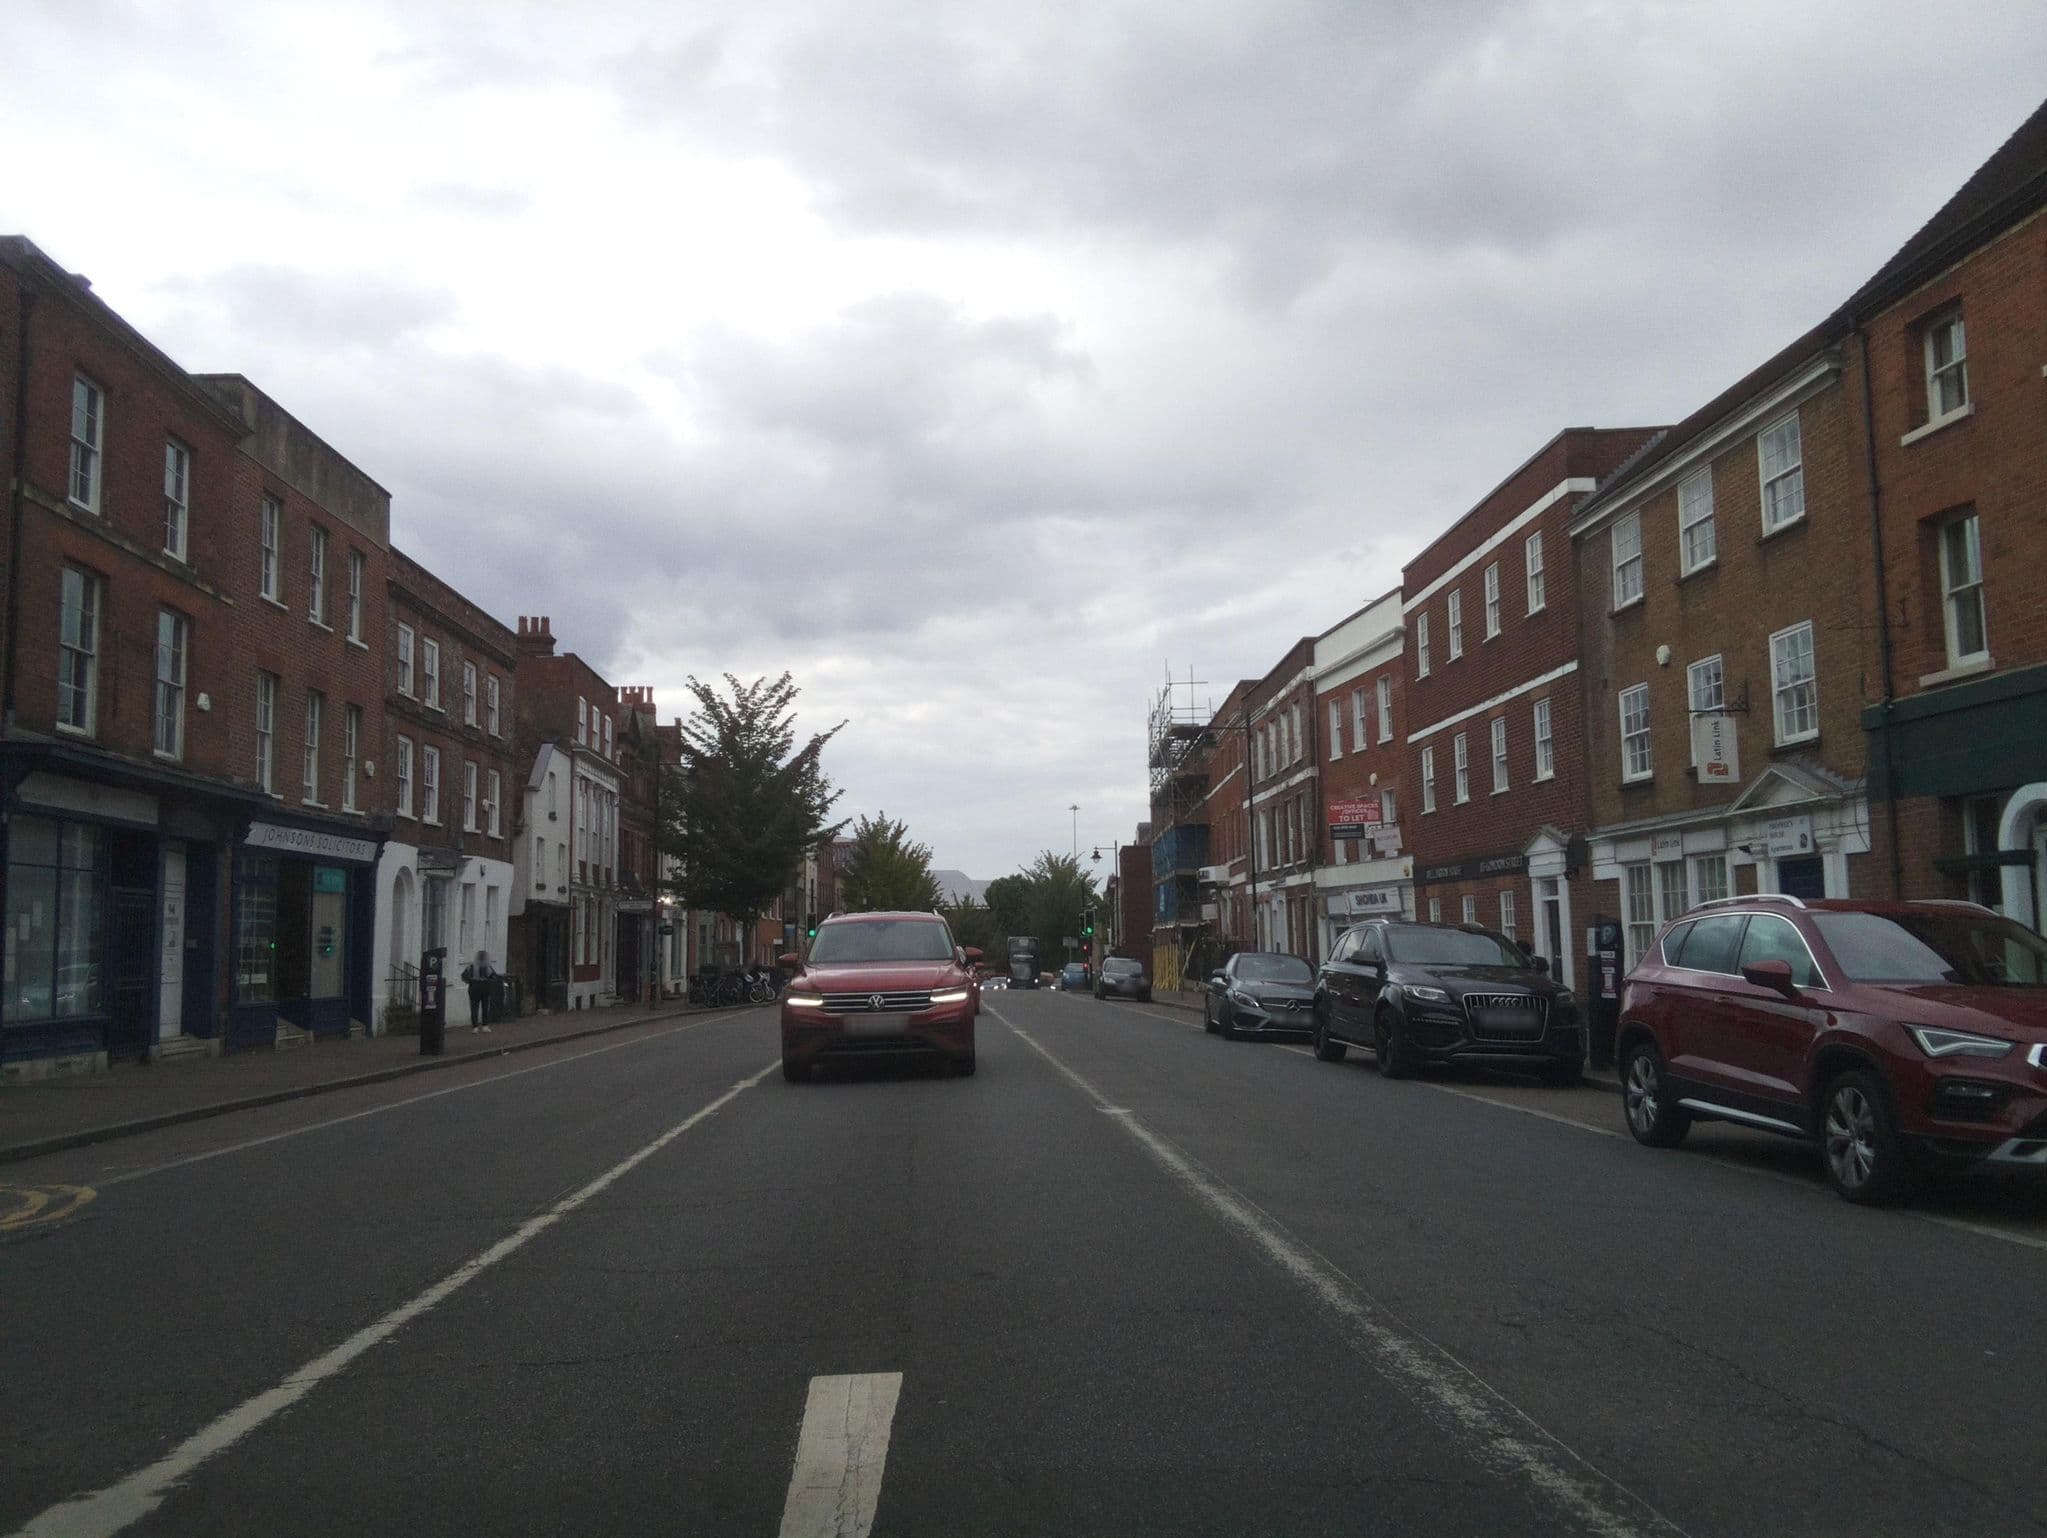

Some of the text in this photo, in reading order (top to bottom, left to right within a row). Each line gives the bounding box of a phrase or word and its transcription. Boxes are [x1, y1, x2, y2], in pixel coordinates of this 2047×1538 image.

[1712, 720, 1722, 760] Latin Link
[1351, 814, 1364, 822] LET
[263, 828, 366, 856] JOHNSONS SOLICITORS
[430, 957, 438, 968] P
